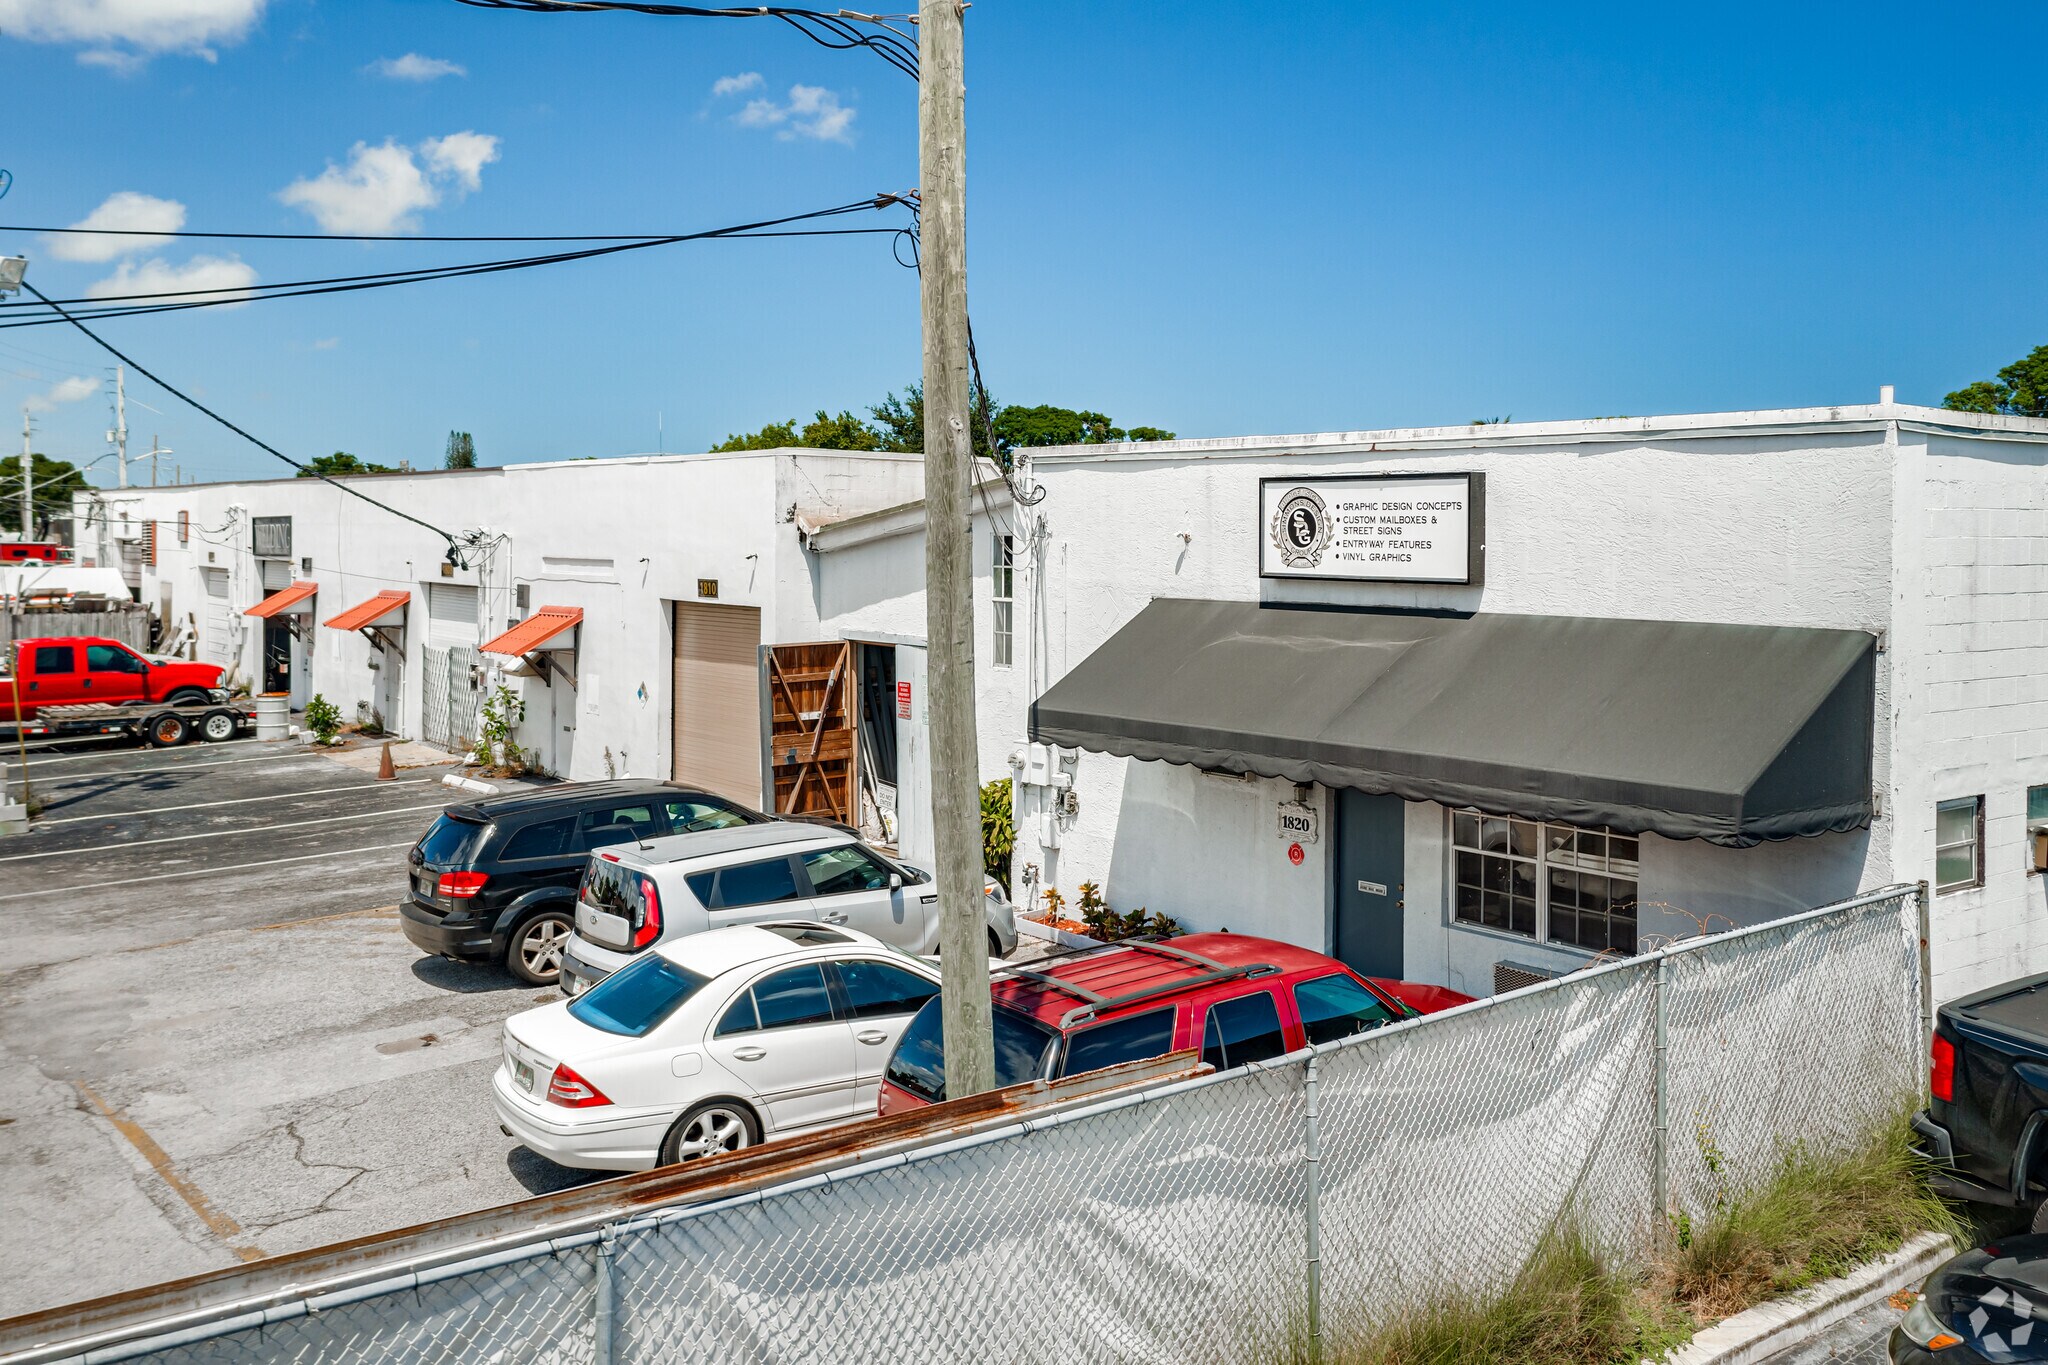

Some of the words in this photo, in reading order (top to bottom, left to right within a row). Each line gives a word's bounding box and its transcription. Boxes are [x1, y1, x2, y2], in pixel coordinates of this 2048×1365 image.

[1342, 502, 1379, 511] GRAPHIC
[1382, 502, 1413, 511] DESIGN
[1416, 501, 1462, 511] CONCEPTS
[1281, 500, 1304, 533] SIMMONS
[1305, 501, 1323, 534] DESIGN
[1342, 516, 1376, 524] CUSTOM
[1379, 516, 1427, 524] MAILBOXES
[1431, 515, 1438, 524] &
[1343, 526, 1374, 535] STREET
[1377, 527, 1403, 535] SIGNS
[1342, 540, 1385, 548] ENTRYWAY
[1388, 540, 1432, 549] FEATURES
[1290, 547, 1312, 556] GROUP
[1342, 553, 1366, 561] VINYL
[1369, 553, 1412, 562] GRAPHICS
[700, 581, 717, 595] 1810
[1281, 815, 1310, 832] 1820
